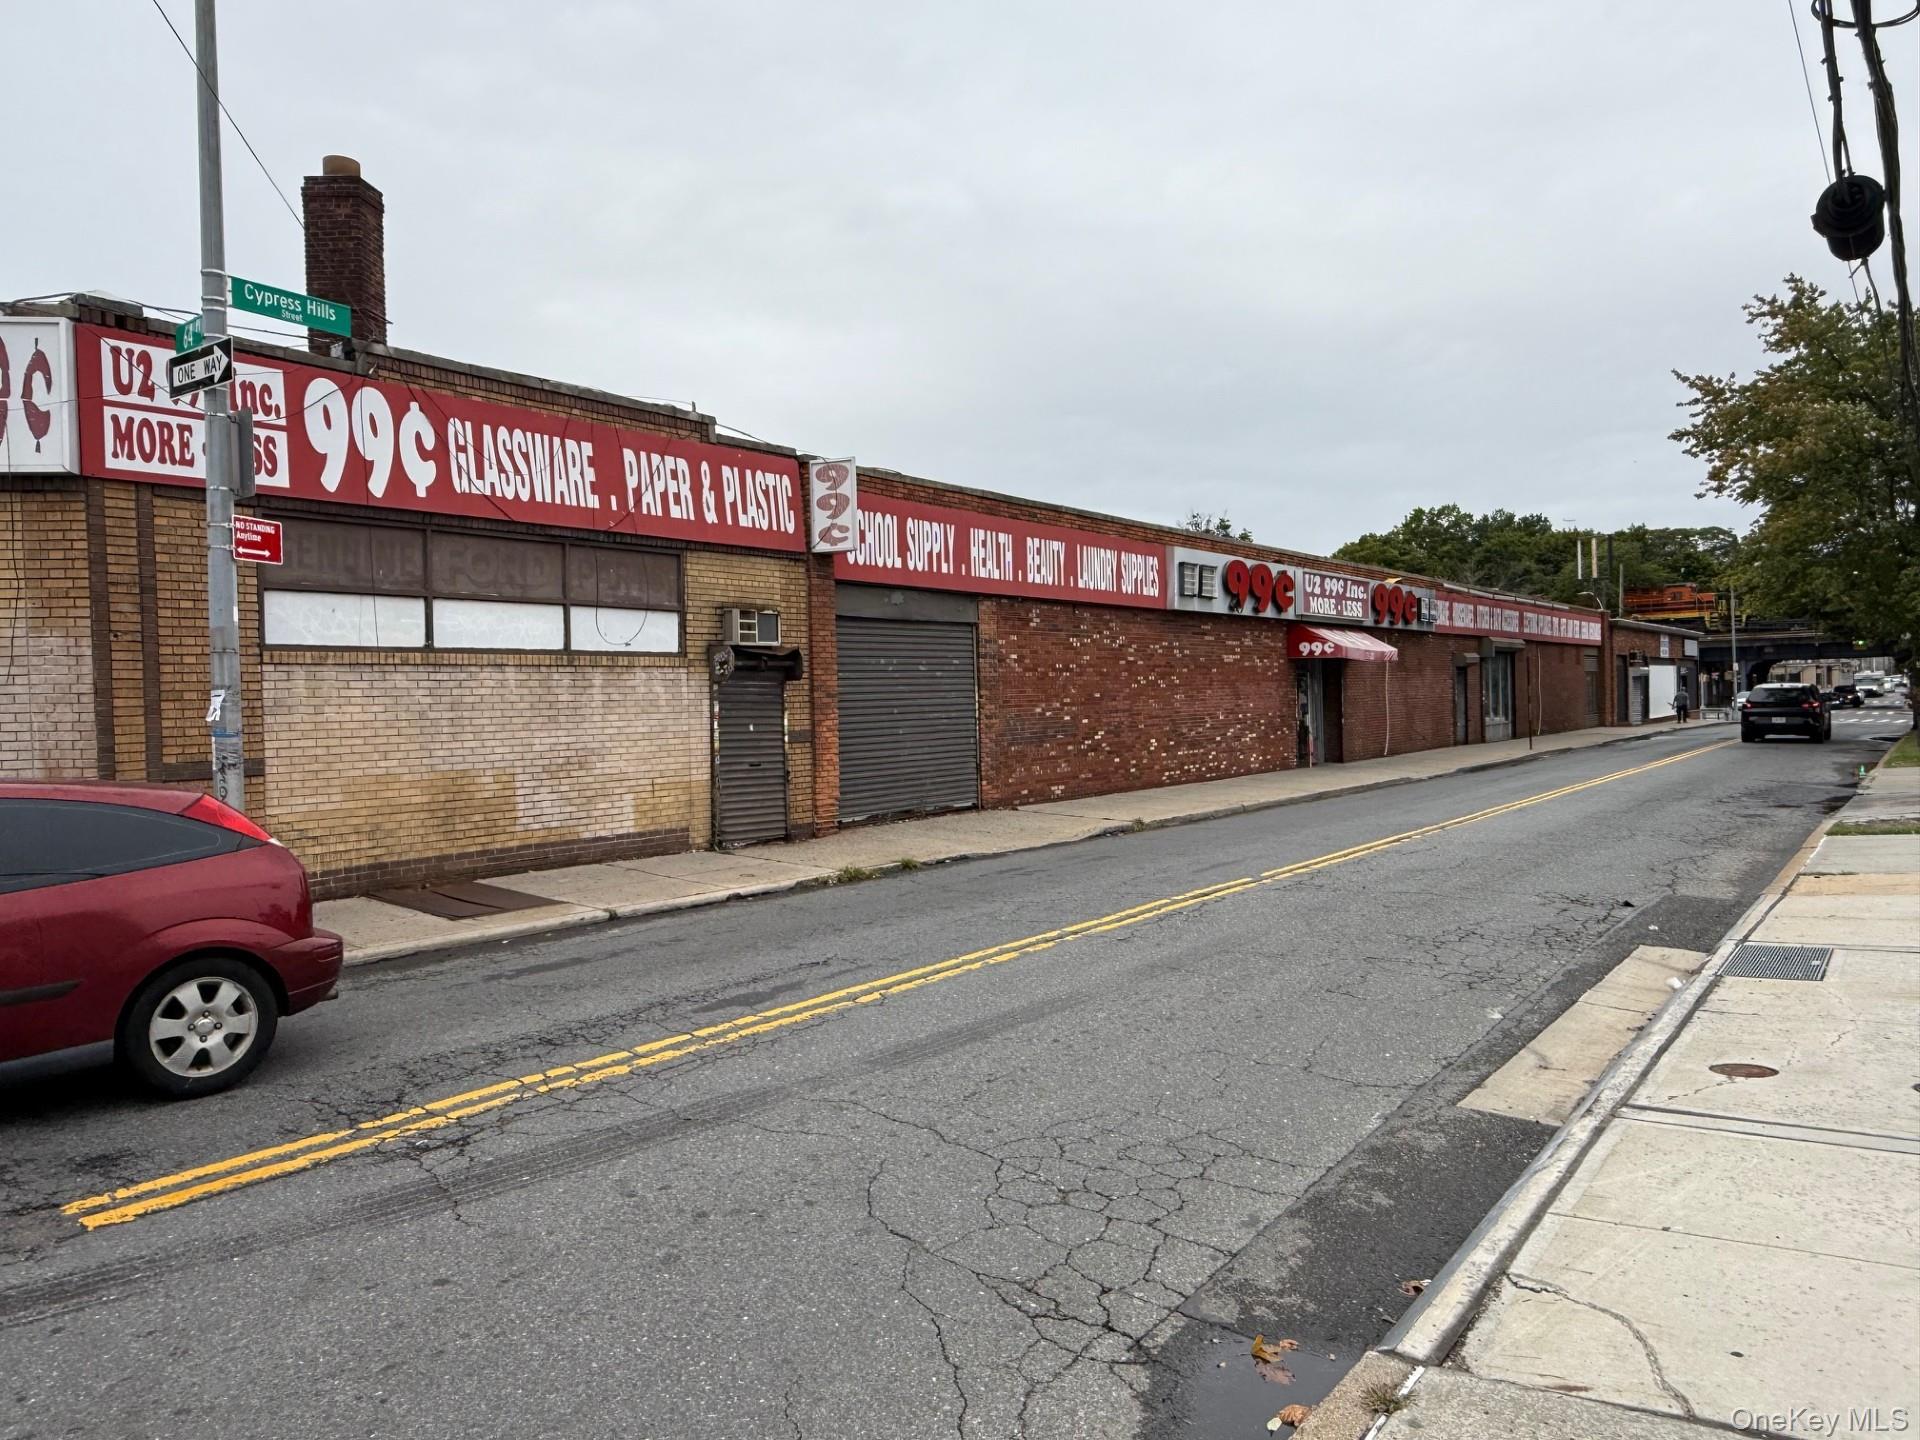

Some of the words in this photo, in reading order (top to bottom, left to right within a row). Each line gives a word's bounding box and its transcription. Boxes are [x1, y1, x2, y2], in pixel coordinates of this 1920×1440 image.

[243, 283, 302, 312] Cypress
[306, 299, 337, 321] Hills
[281, 309, 303, 322] Street
[183, 322, 193, 350] 64
[109, 344, 156, 402] U2
[177, 363, 196, 384] ONE
[203, 354, 223, 375] WAY
[110, 413, 195, 468] MORE
[304, 377, 437, 499] 99¢
[447, 417, 600, 509] GLASSWARE
[623, 447, 695, 521] PAPER
[700, 460, 719, 524] &
[721, 464, 795, 535] PLASTIC
[235, 520, 245, 529] NO
[246, 522, 275, 535] STANDING
[236, 530, 262, 542] Anytime
[906, 517, 955, 575] SUPPLY
[969, 527, 1013, 582] HEALTH
[1026, 536, 1066, 587] BEAUTY
[1077, 544, 1117, 593] LAUNDRY
[1121, 551, 1159, 599] SUPPLIES
[1223, 559, 1295, 614] 99¢
[1304, 573, 1321, 595] U2
[1324, 577, 1344, 596] 99¢
[1345, 580, 1367, 600] Inc.
[1309, 596, 1337, 615] MORE
[1342, 599, 1363, 617] LESS
[1372, 583, 1418, 625] 99¢
[1298, 641, 1335, 657] 99¢
